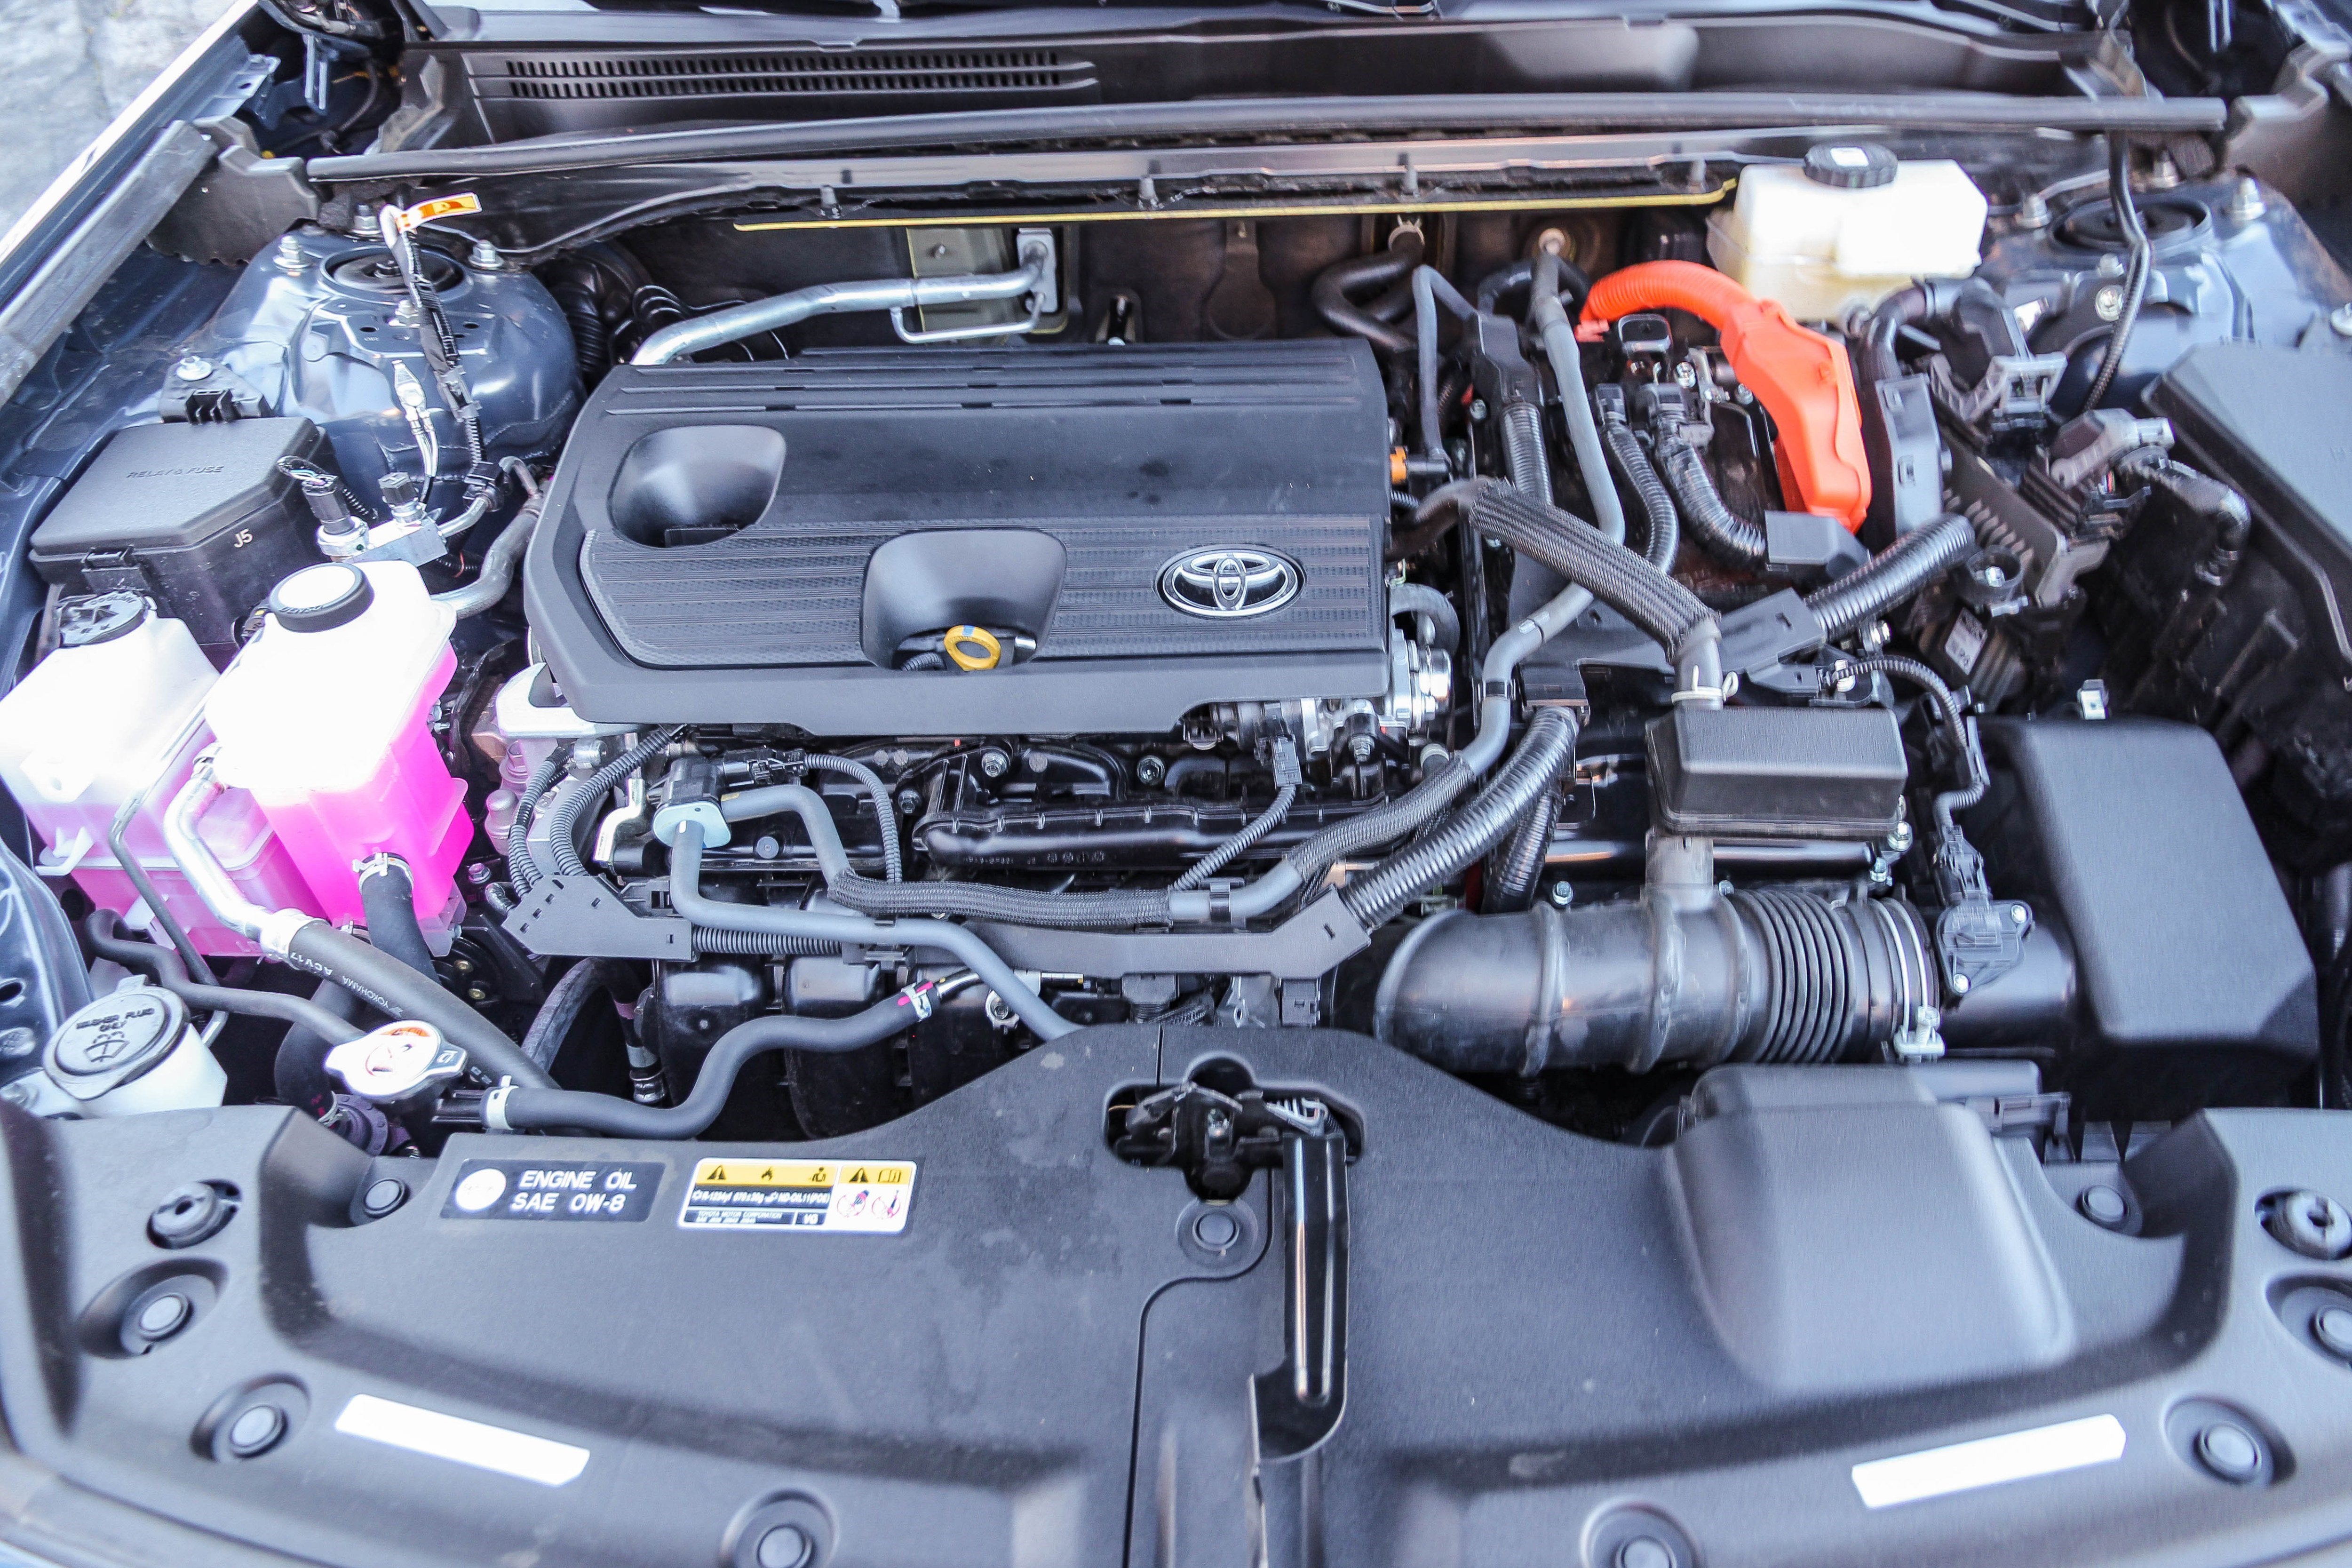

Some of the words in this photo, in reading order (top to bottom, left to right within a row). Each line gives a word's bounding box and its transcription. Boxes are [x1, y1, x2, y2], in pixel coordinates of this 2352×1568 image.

[187, 465, 224, 474] FUSE
[234, 528, 253, 549] J5
[342, 975, 389, 1009] YOKOHAMA
[519, 1170, 598, 1189] ENGINE
[604, 1170, 638, 1191] OIL
[510, 1192, 560, 1212] SAE
